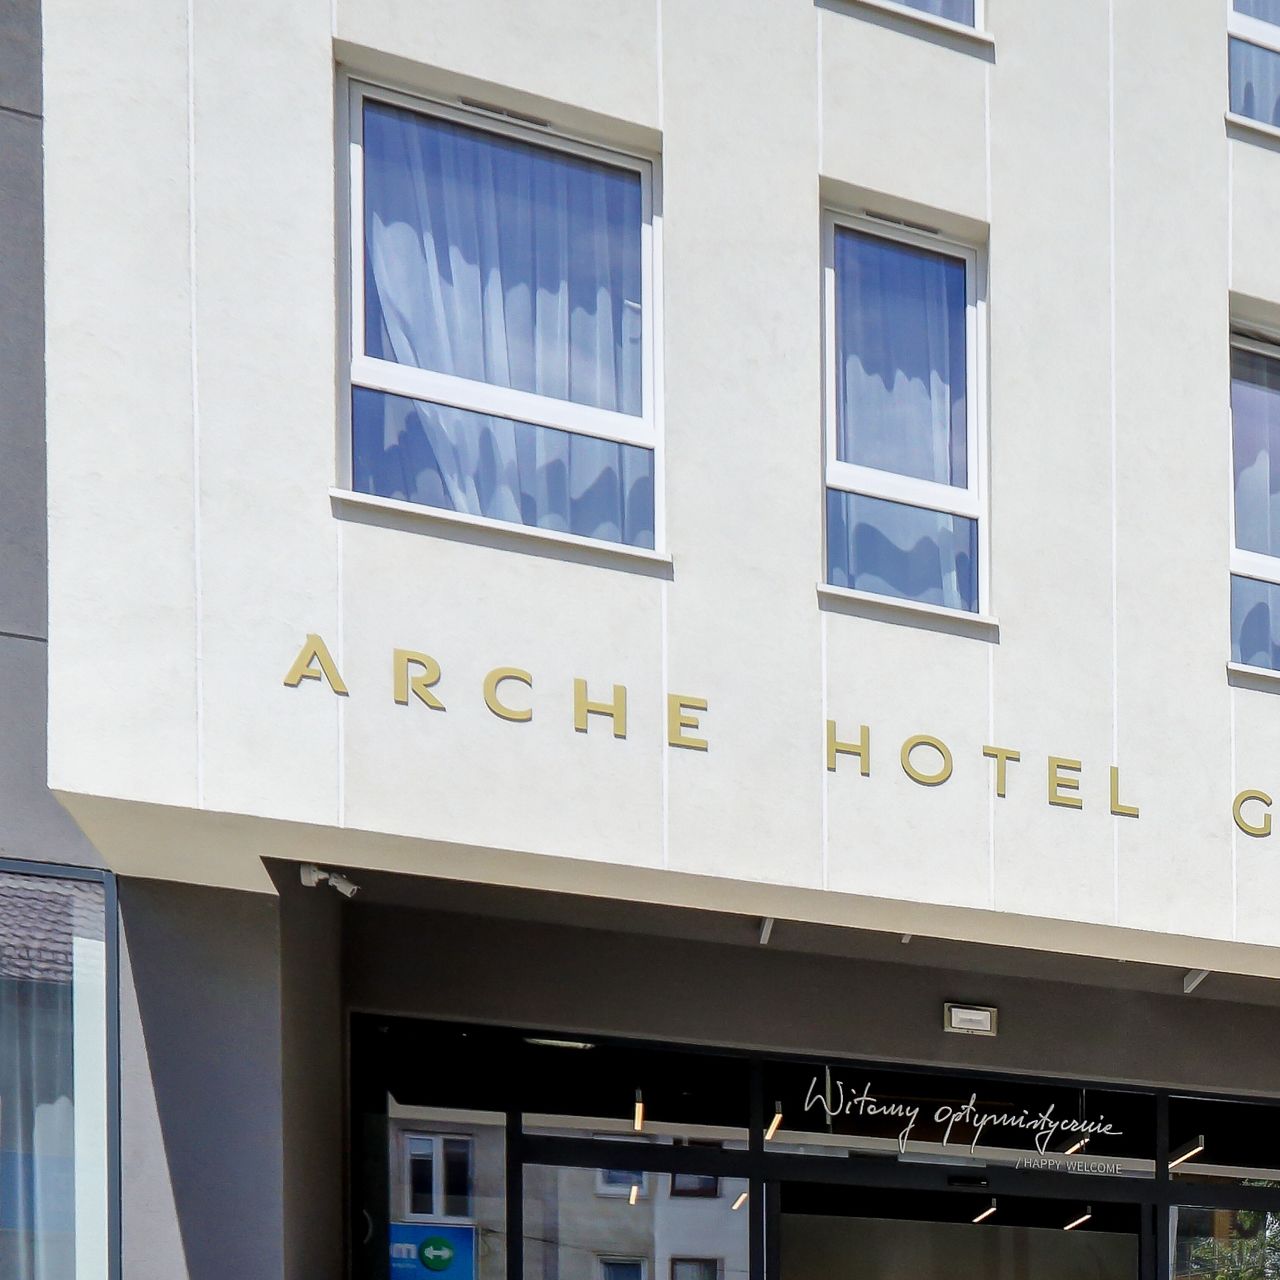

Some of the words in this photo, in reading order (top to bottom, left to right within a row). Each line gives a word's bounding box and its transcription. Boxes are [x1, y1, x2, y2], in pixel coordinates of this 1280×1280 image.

[283, 633, 710, 752] ARCHE
[826, 720, 1141, 818] HOTEL
[804, 1076, 920, 1154] Witamy
[933, 1092, 1124, 1156] optymistycznie
[1066, 1161, 1123, 1174] WELCOME
